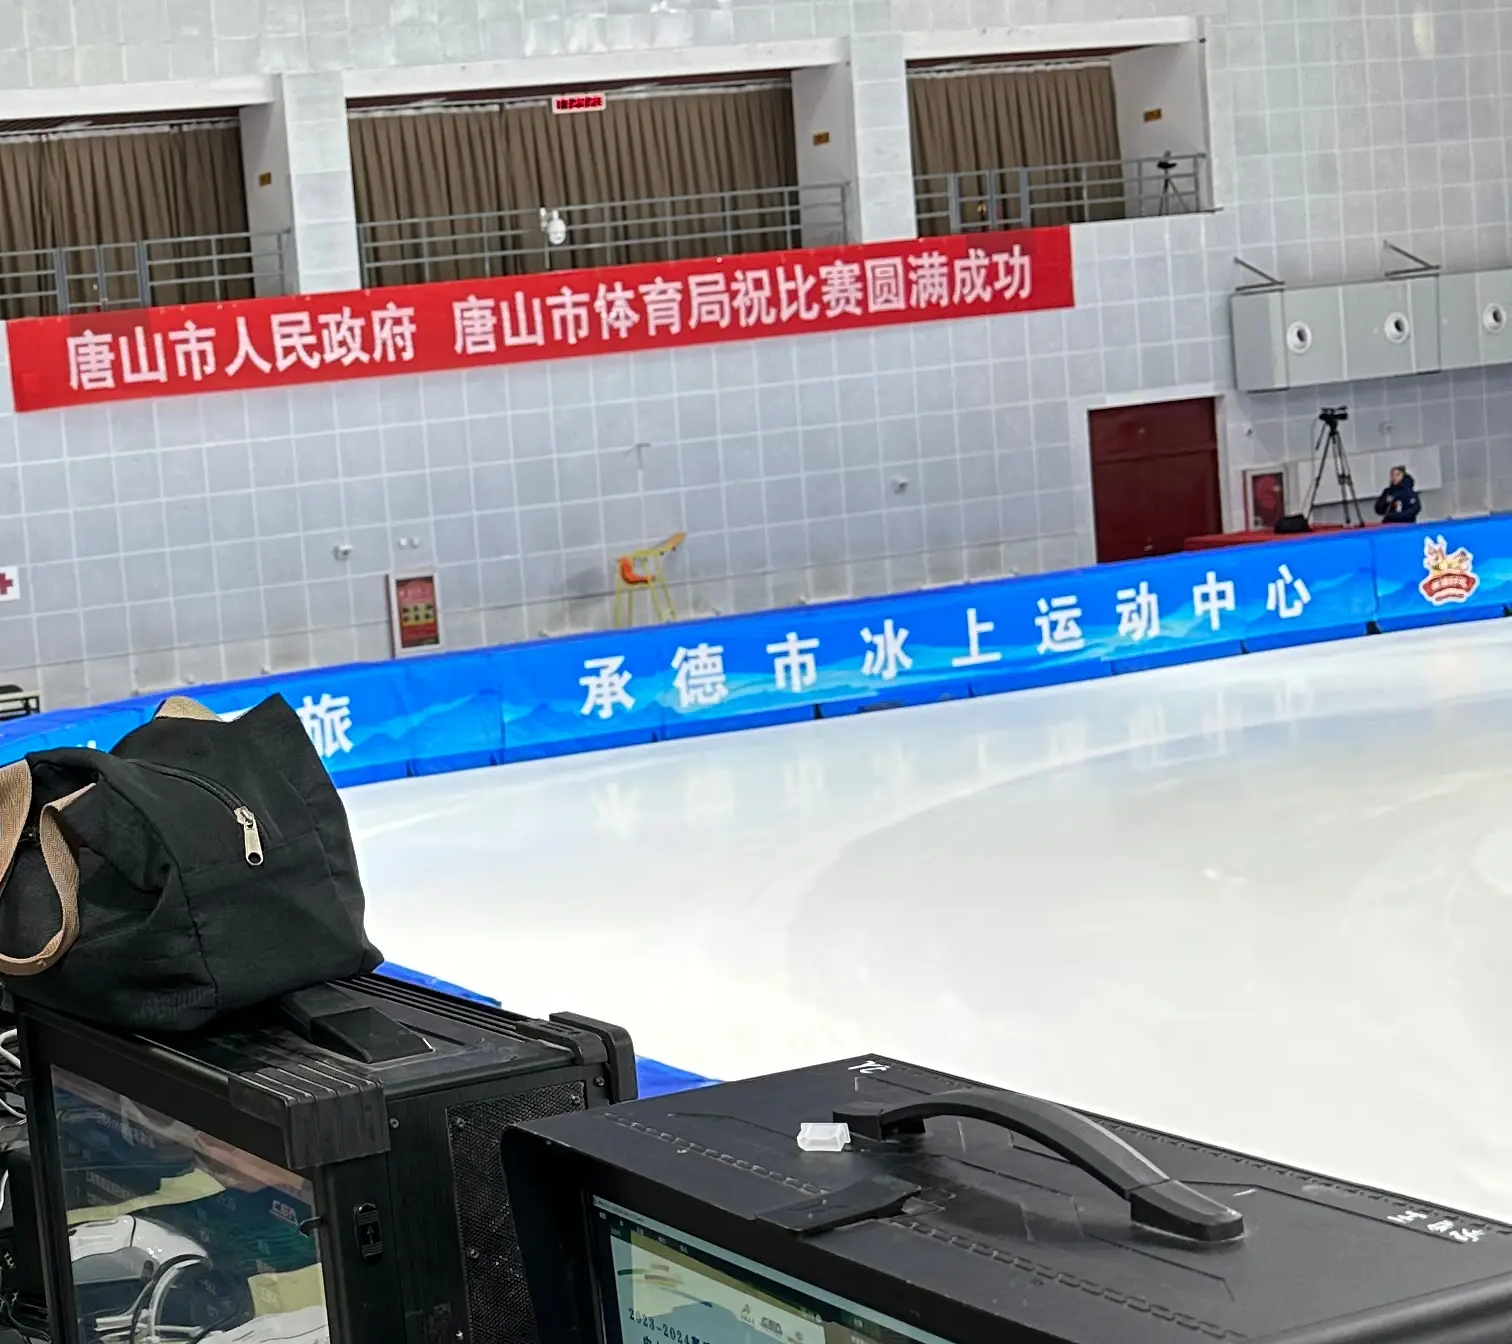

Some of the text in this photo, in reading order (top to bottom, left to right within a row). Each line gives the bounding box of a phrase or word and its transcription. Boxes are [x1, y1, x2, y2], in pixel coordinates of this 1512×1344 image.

[66, 243, 1033, 392] 唐山市人民政府 唐山市体育局祝比赛圆满成功
[578, 564, 1314, 720] 承德市冰上运动中心
[300, 694, 354, 759] 旅
